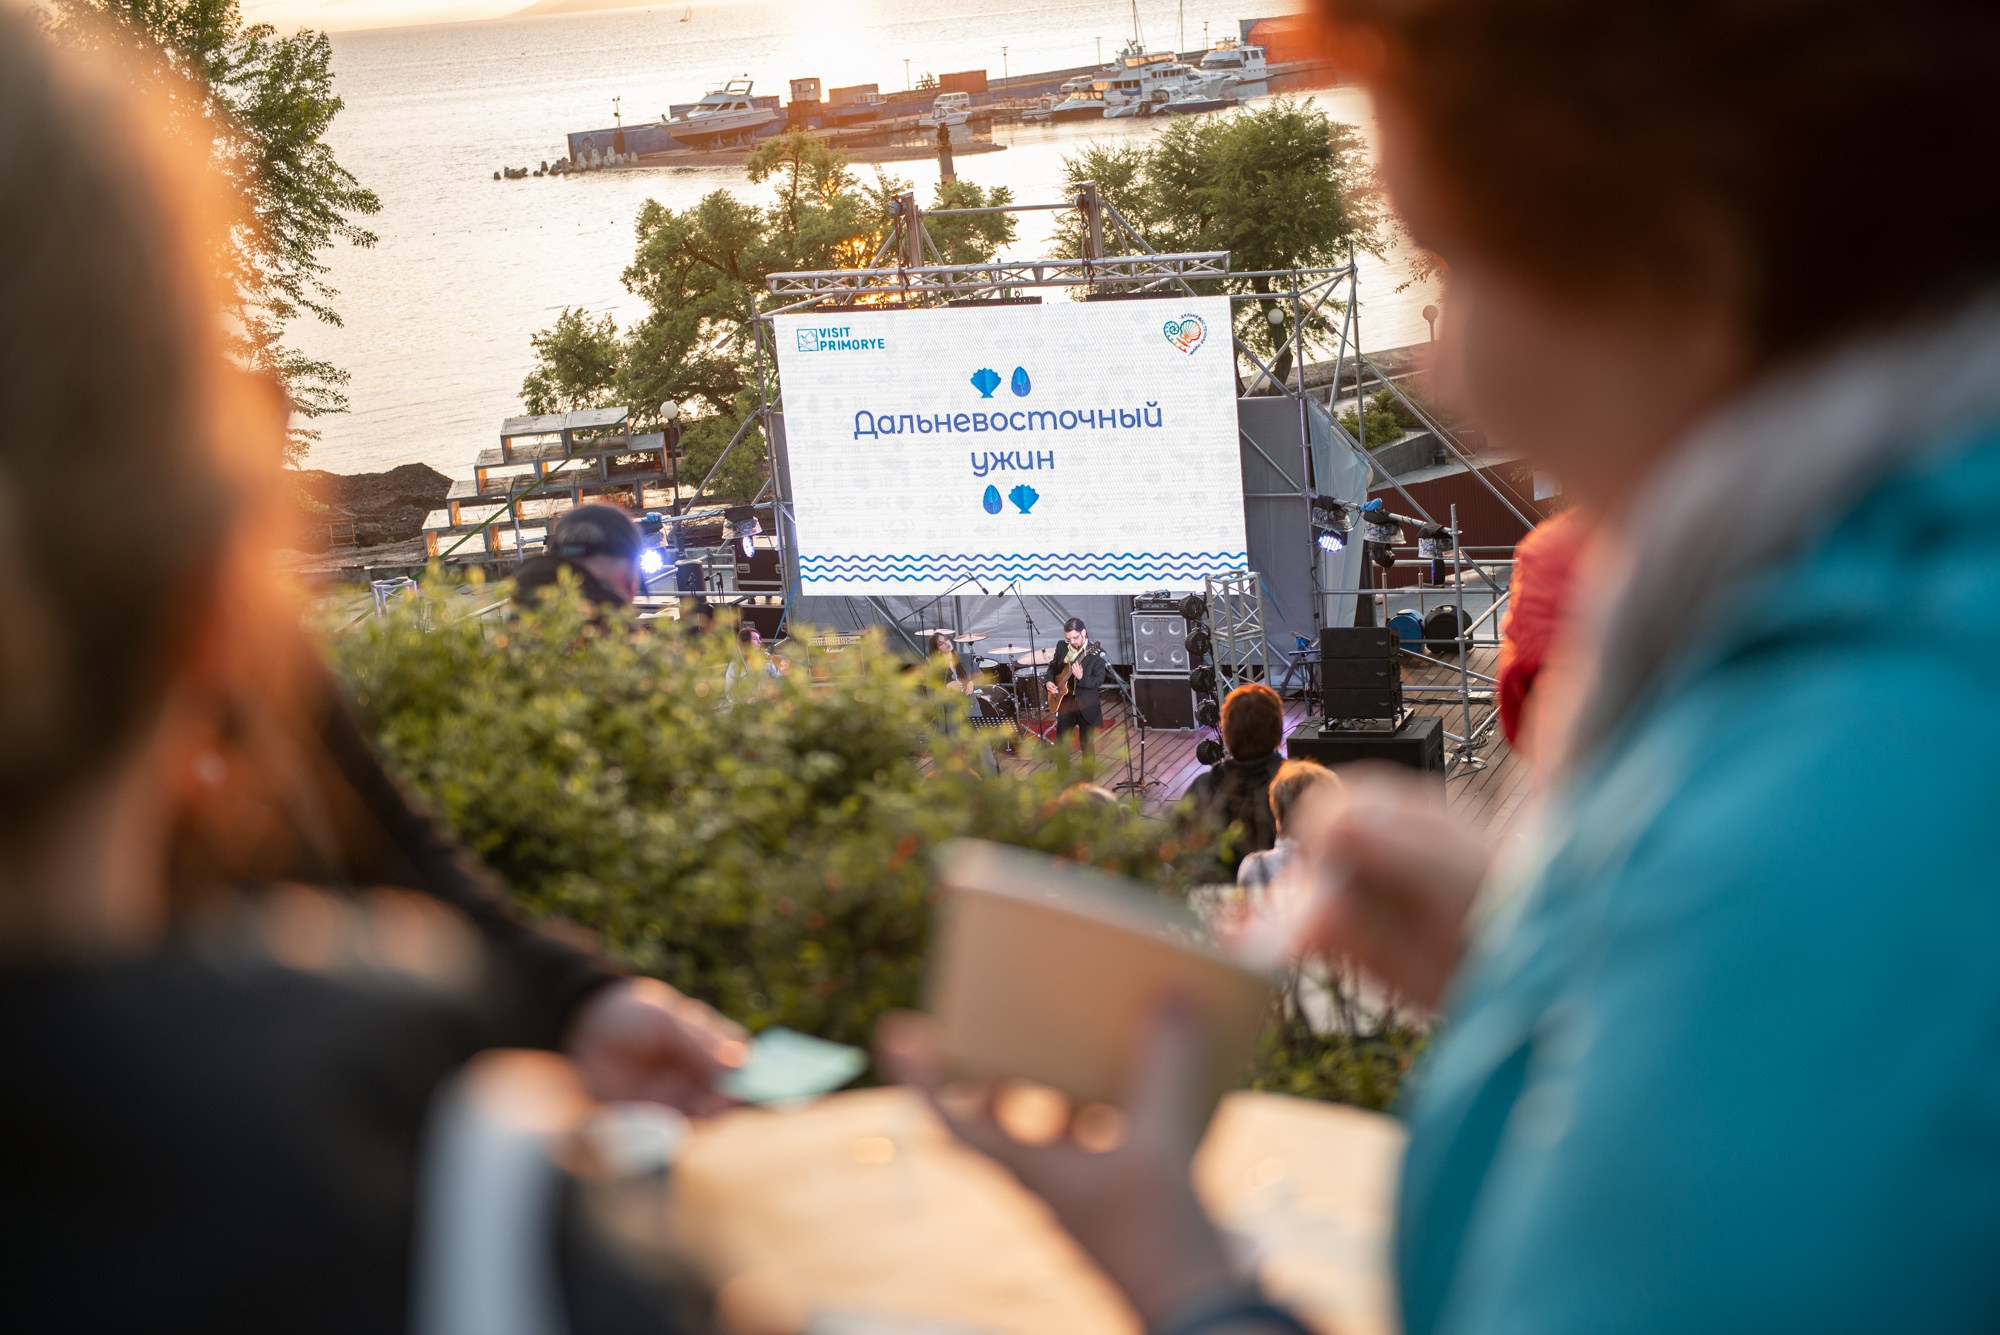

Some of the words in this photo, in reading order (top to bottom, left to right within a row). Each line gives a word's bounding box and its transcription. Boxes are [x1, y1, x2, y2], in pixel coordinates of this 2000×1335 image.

[819, 327, 850, 338] VISIT
[820, 338, 885, 351] PRIMORYE
[853, 401, 1163, 440] Дальневосточный
[971, 450, 1055, 477] ужин
